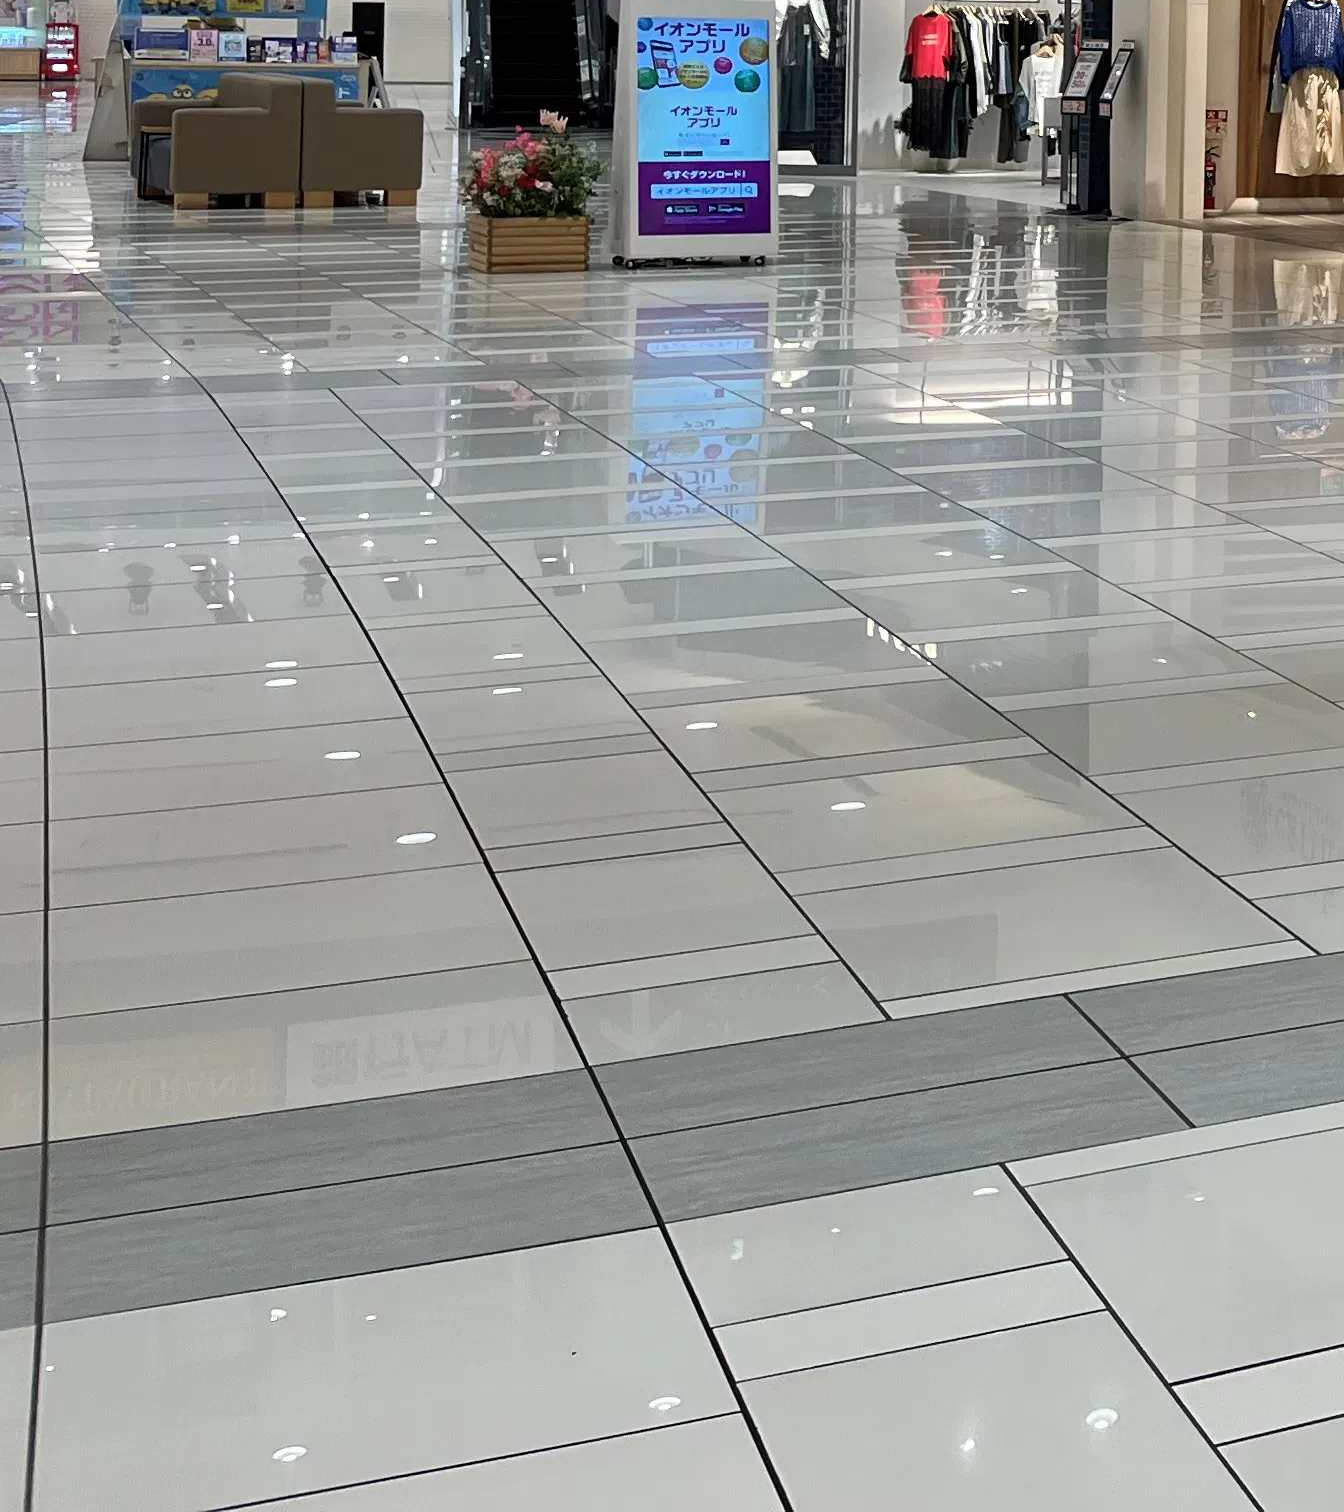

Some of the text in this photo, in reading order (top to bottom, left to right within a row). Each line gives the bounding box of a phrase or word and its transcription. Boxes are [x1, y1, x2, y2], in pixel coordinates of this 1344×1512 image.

[653, 22, 751, 38] イオンモール
[679, 39, 726, 53] アプリ
[670, 105, 738, 116] イオンモール
[687, 117, 721, 128] アプリ
[663, 169, 746, 180] 今すぐダウンロード!
